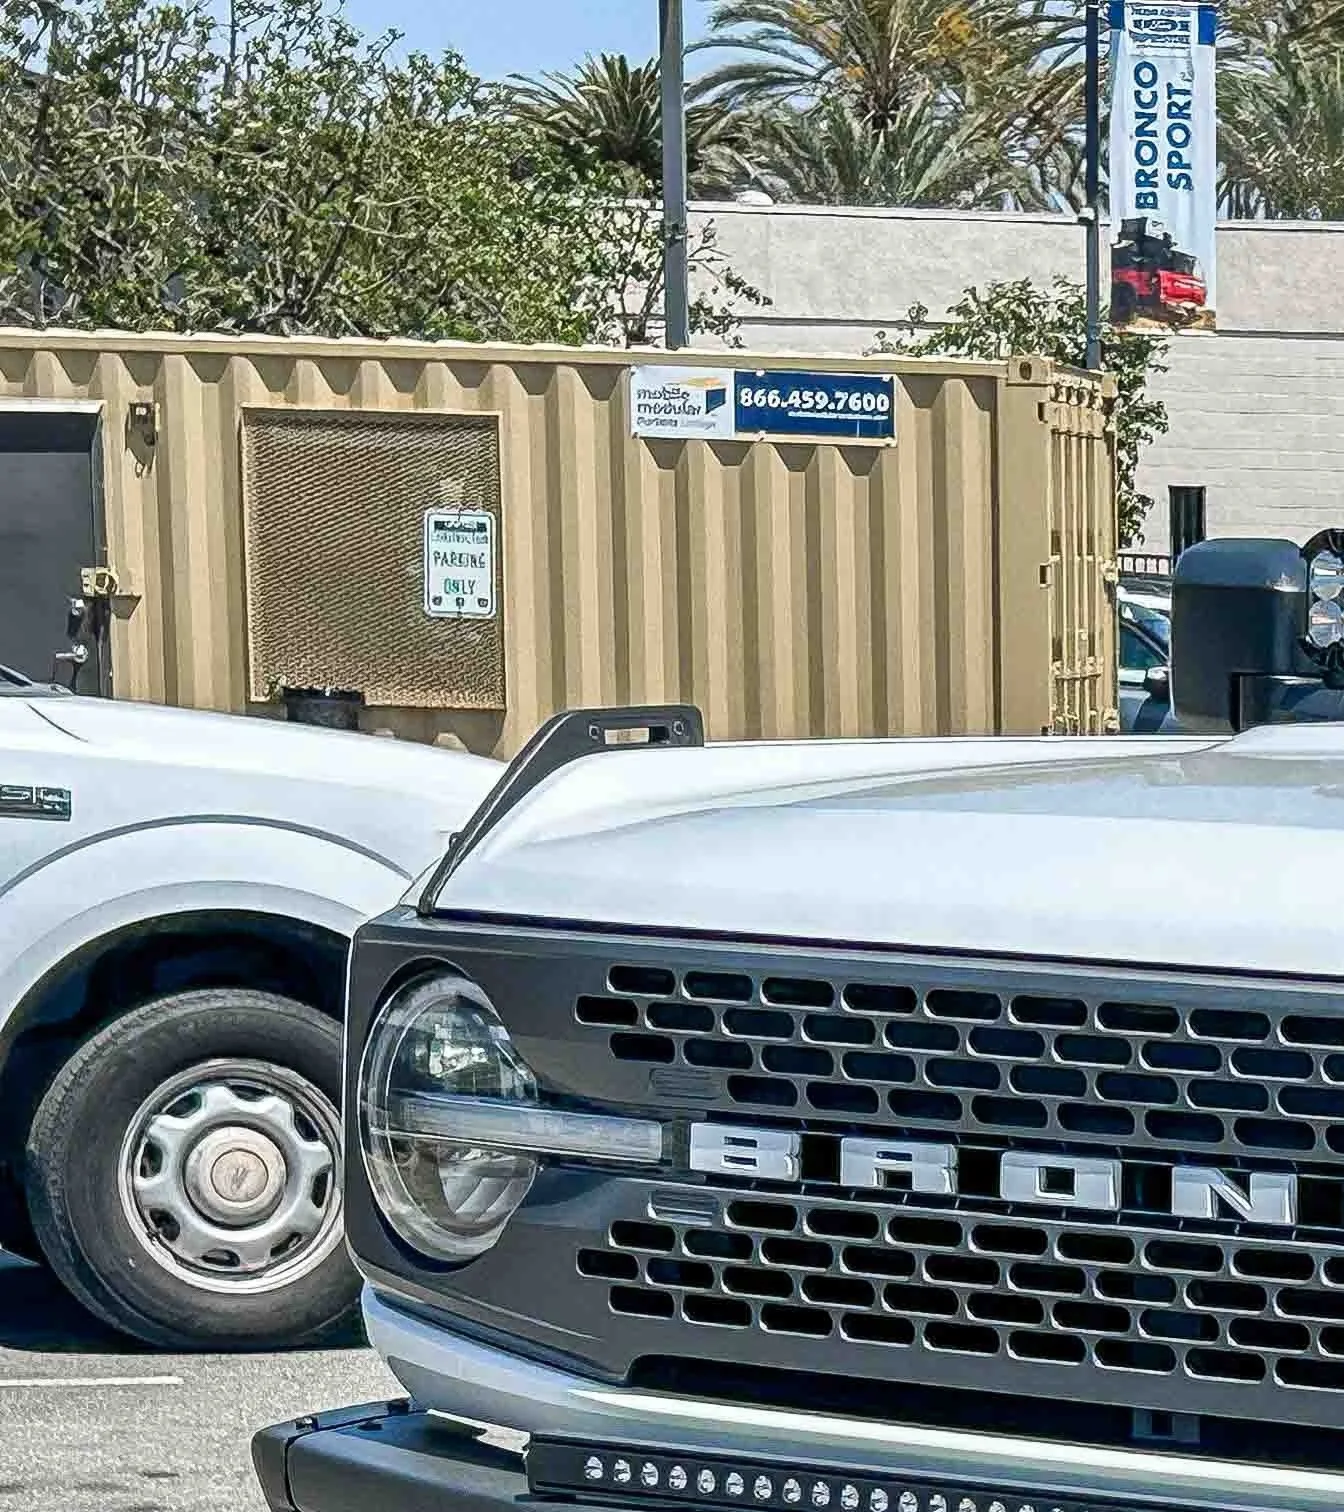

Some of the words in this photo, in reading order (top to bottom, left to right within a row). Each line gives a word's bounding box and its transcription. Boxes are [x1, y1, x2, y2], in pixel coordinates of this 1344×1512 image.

[1133, 60, 1160, 210] BRONCO
[1166, 82, 1193, 192] SPORT
[739, 387, 890, 413] 866.459.7600
[443, 578, 476, 595] ONLY
